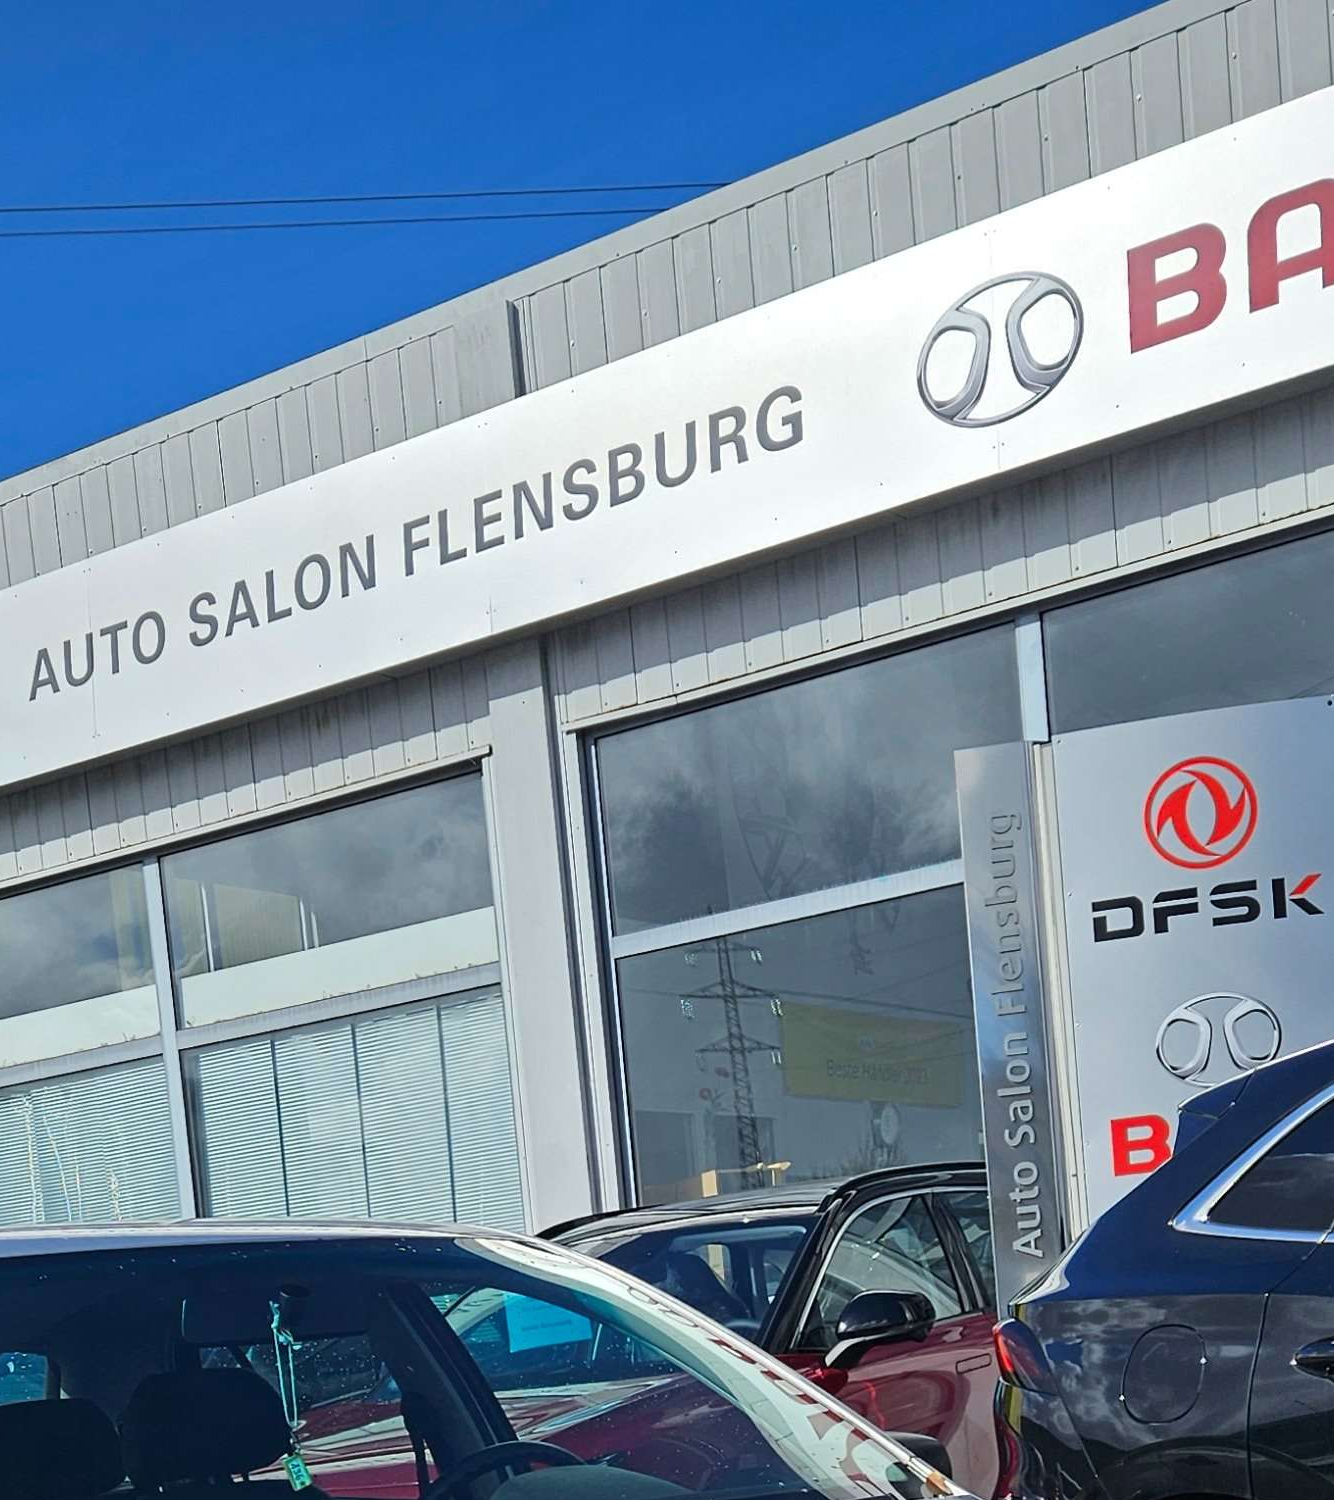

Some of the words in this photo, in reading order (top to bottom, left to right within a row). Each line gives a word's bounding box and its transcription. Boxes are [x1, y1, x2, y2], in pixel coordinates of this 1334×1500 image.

[28, 611, 166, 702] AUTO
[189, 534, 377, 648] SALON
[403, 385, 804, 577] FLENSBURG
[984, 813, 1028, 1017] Flensburg
[1091, 873, 1325, 943] DFSK
[996, 1032, 1036, 1150] Salon
[1009, 1161, 1044, 1258] Auto
